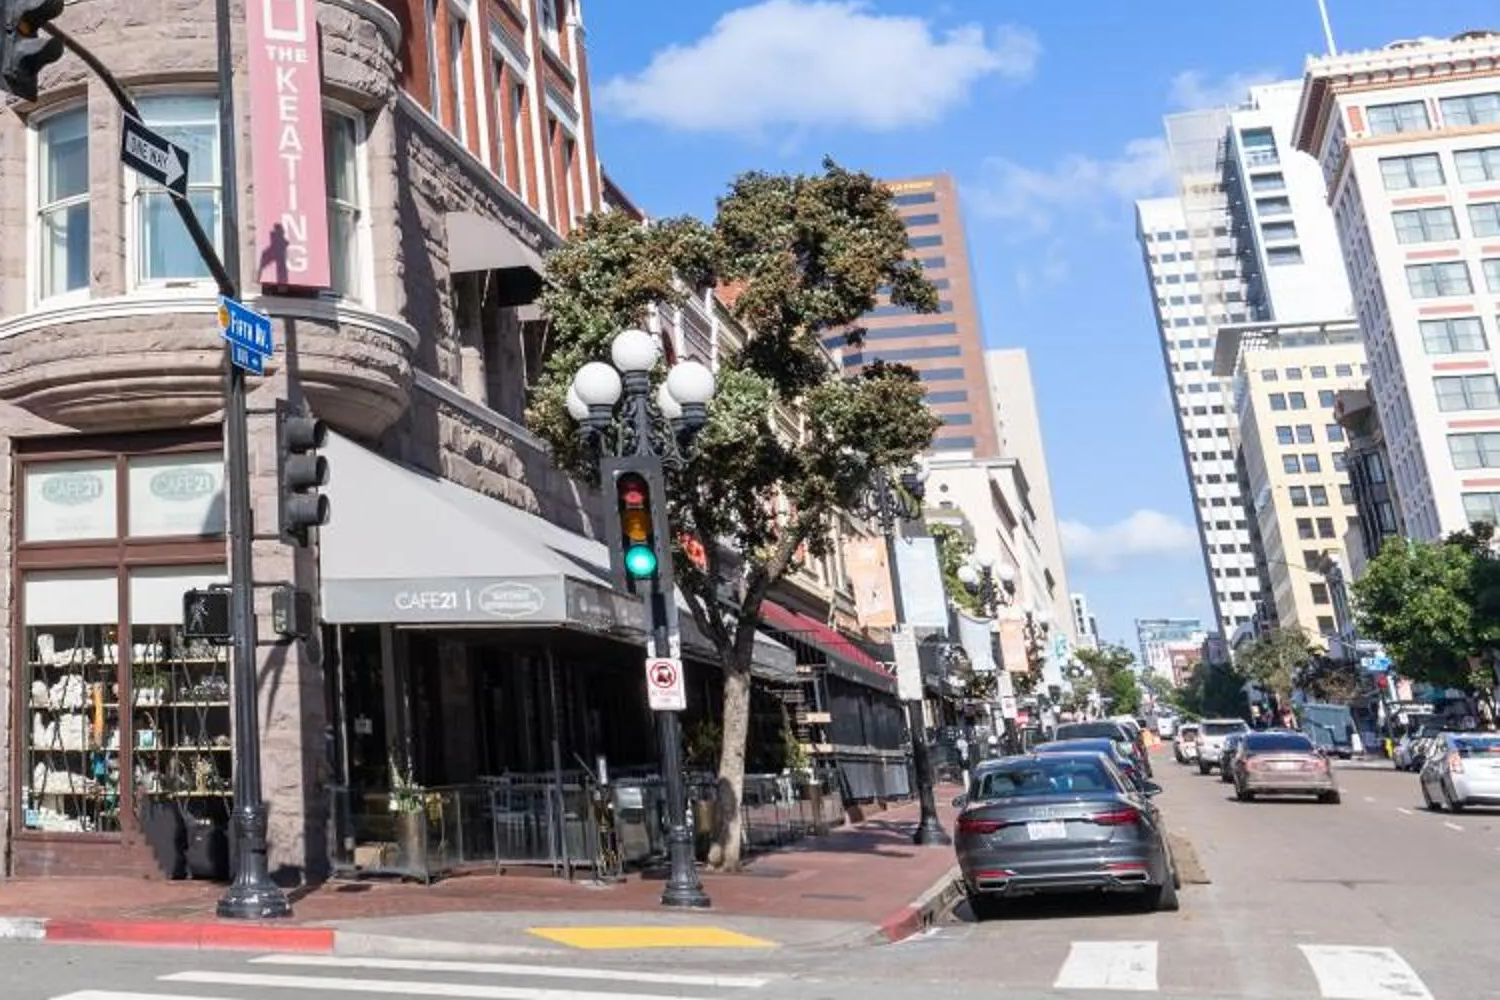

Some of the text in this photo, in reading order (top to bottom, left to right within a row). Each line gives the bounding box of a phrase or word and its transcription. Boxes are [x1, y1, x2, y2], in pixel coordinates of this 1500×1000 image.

[266, 46, 308, 63] THE
[129, 136, 169, 169] ONE WAY
[276, 66, 308, 272] KEATING
